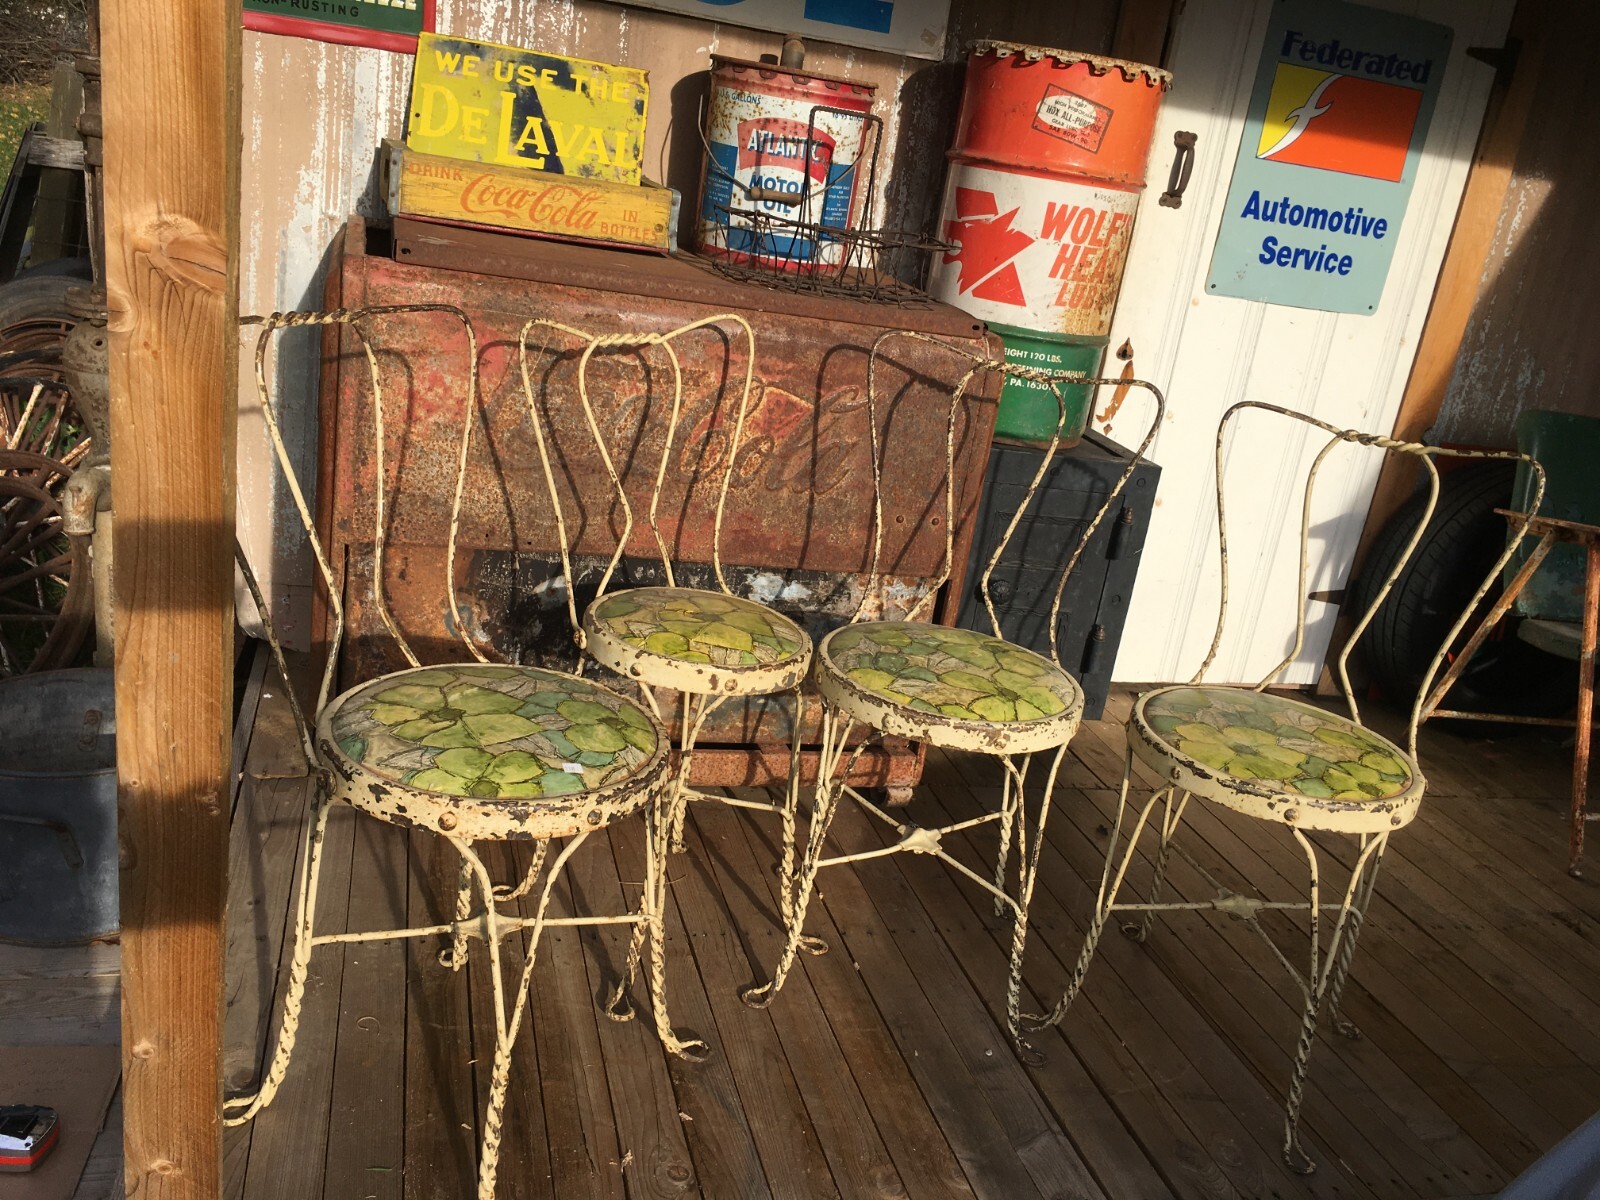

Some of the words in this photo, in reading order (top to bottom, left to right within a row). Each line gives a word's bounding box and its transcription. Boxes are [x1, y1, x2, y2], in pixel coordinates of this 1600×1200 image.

[252, 0, 359, 17] -RUSTING
[1280, 29, 1432, 84] Federated
[435, 50, 480, 77] WE
[494, 60, 558, 89] USE
[569, 73, 631, 104] THE
[747, 128, 824, 162] ATLANTC
[408, 162, 463, 182] DRINK
[749, 174, 804, 195] MOTO
[622, 209, 638, 223] IN
[1240, 190, 1388, 240] Automotive
[600, 222, 658, 242] BOTTLES
[1258, 235, 1353, 276] Service
[1053, 369, 1087, 379] COMPANY
[1027, 381, 1052, 391] 1630
